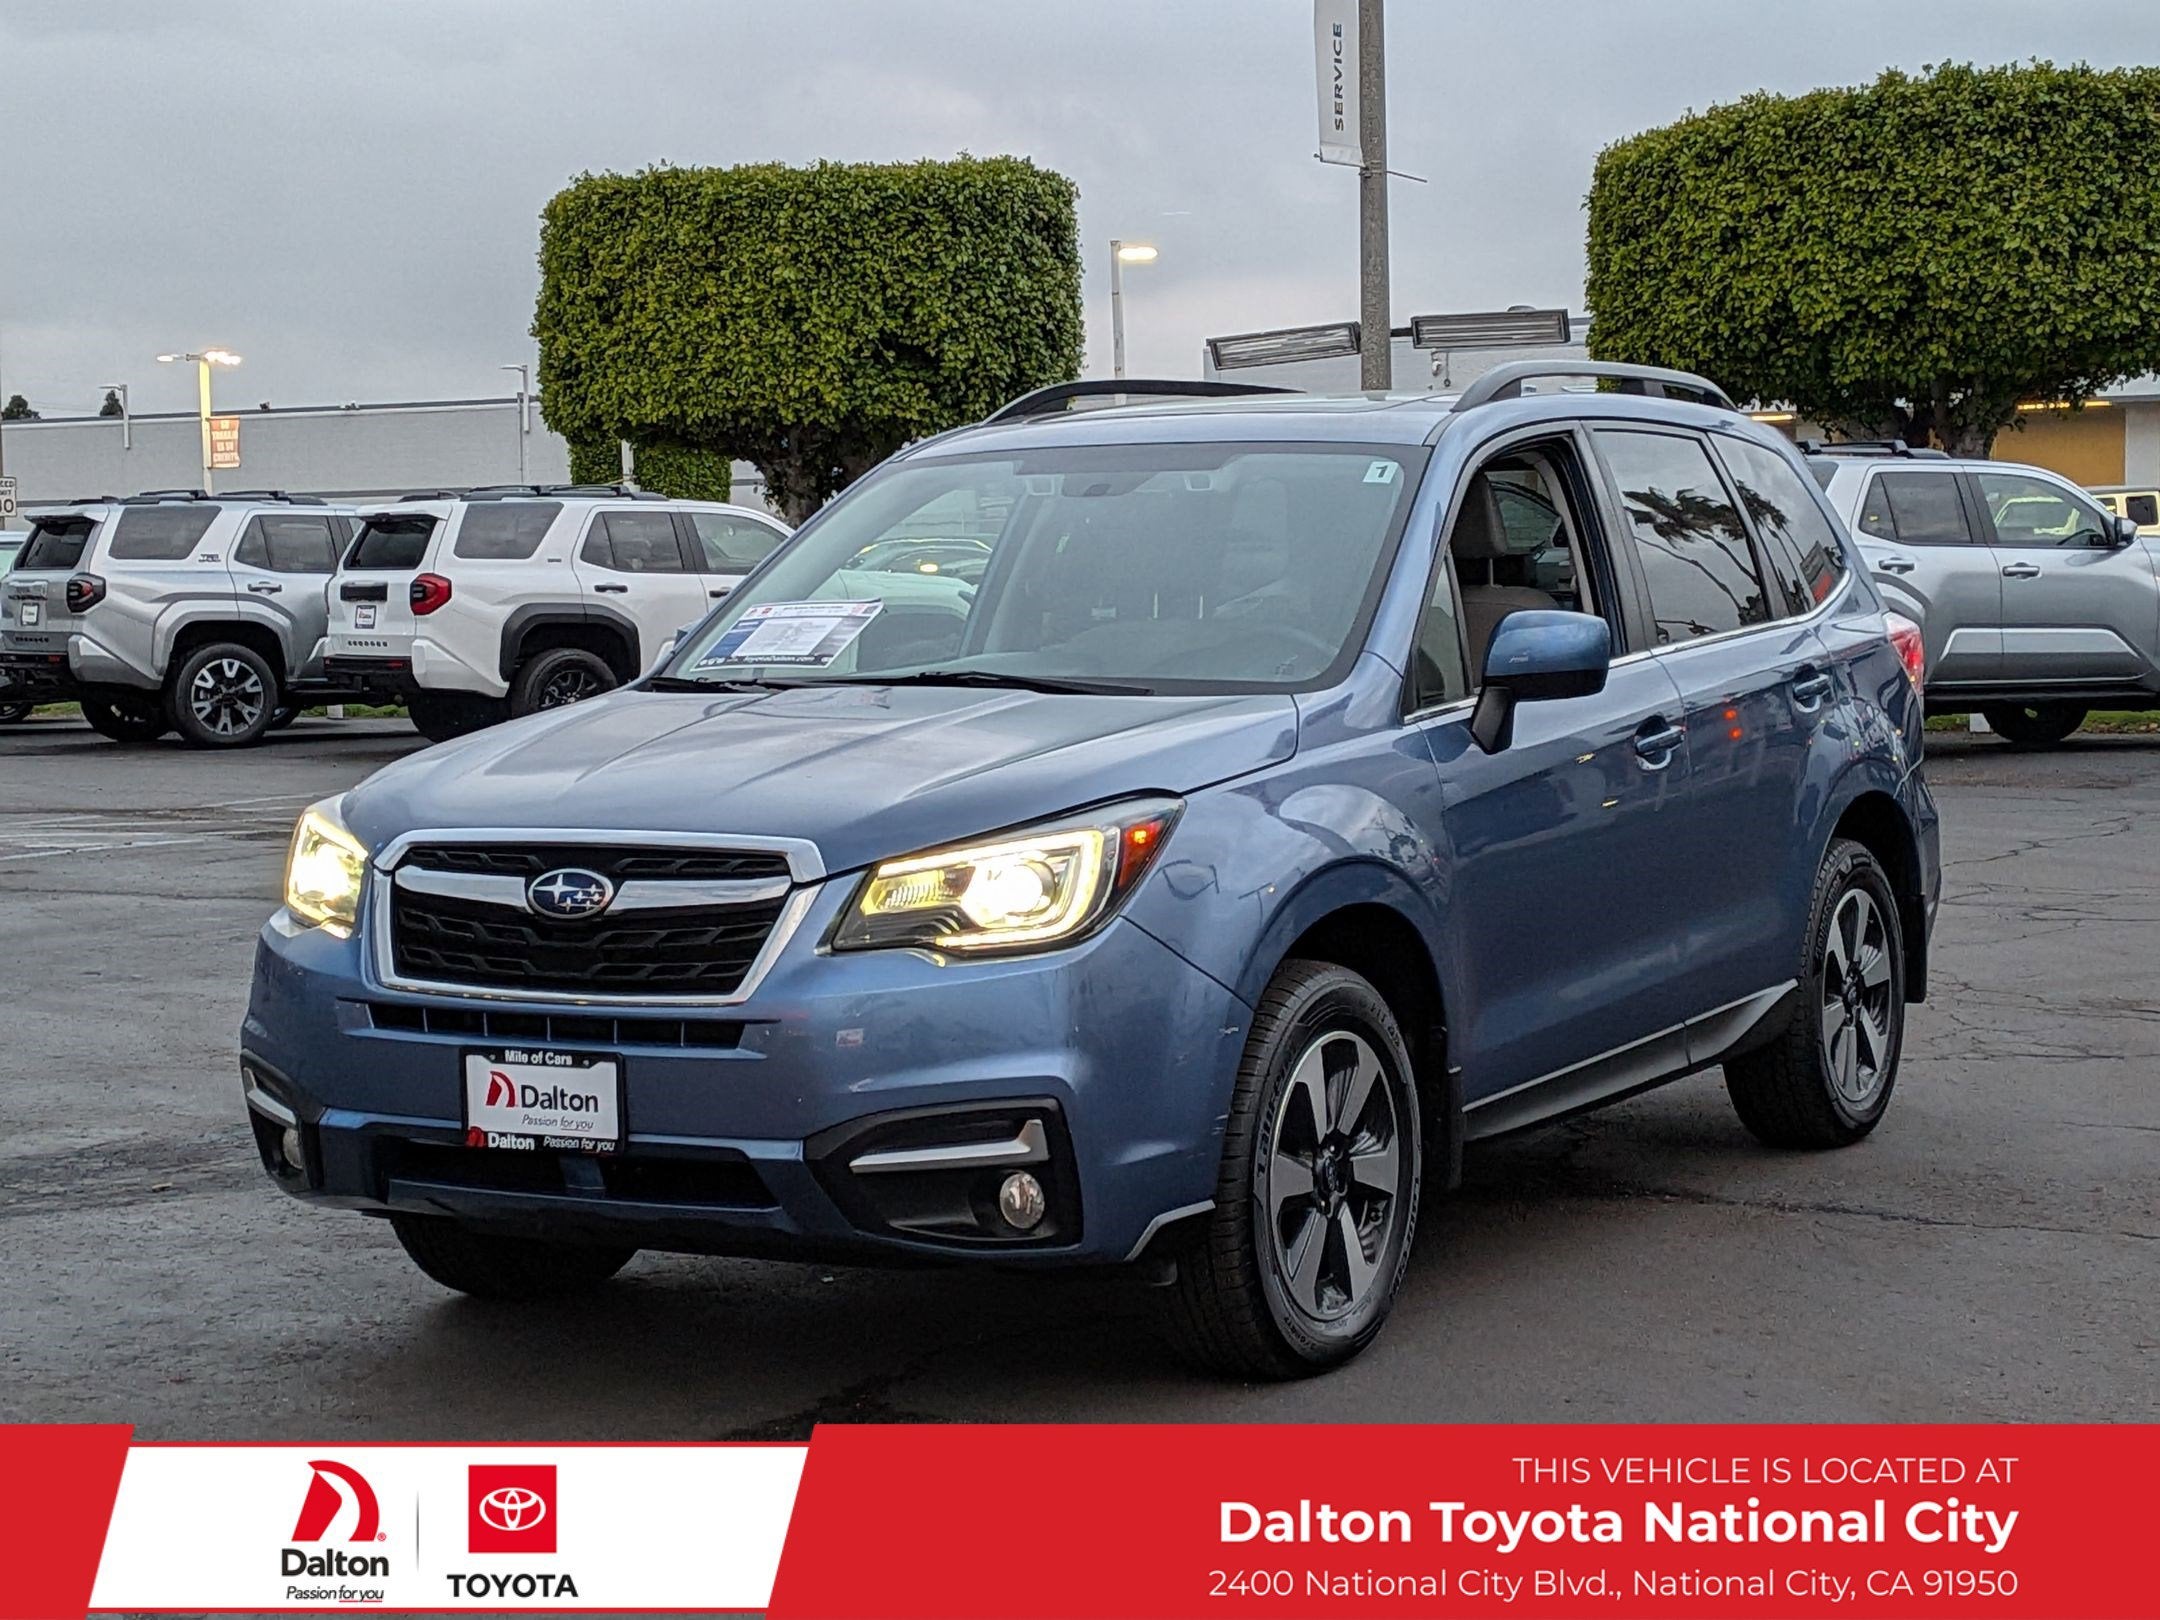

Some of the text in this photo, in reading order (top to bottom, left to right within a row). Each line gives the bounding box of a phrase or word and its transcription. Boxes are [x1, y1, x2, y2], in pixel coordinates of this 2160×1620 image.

[1333, 22, 1345, 132] SERVICE
[1375, 465, 1388, 479] 1
[504, 1050, 573, 1066] Mile of Cars
[520, 1084, 599, 1113] Dalton
[521, 1113, 594, 1131] Passion for you
[487, 1132, 616, 1153] Dalton Passion for you
